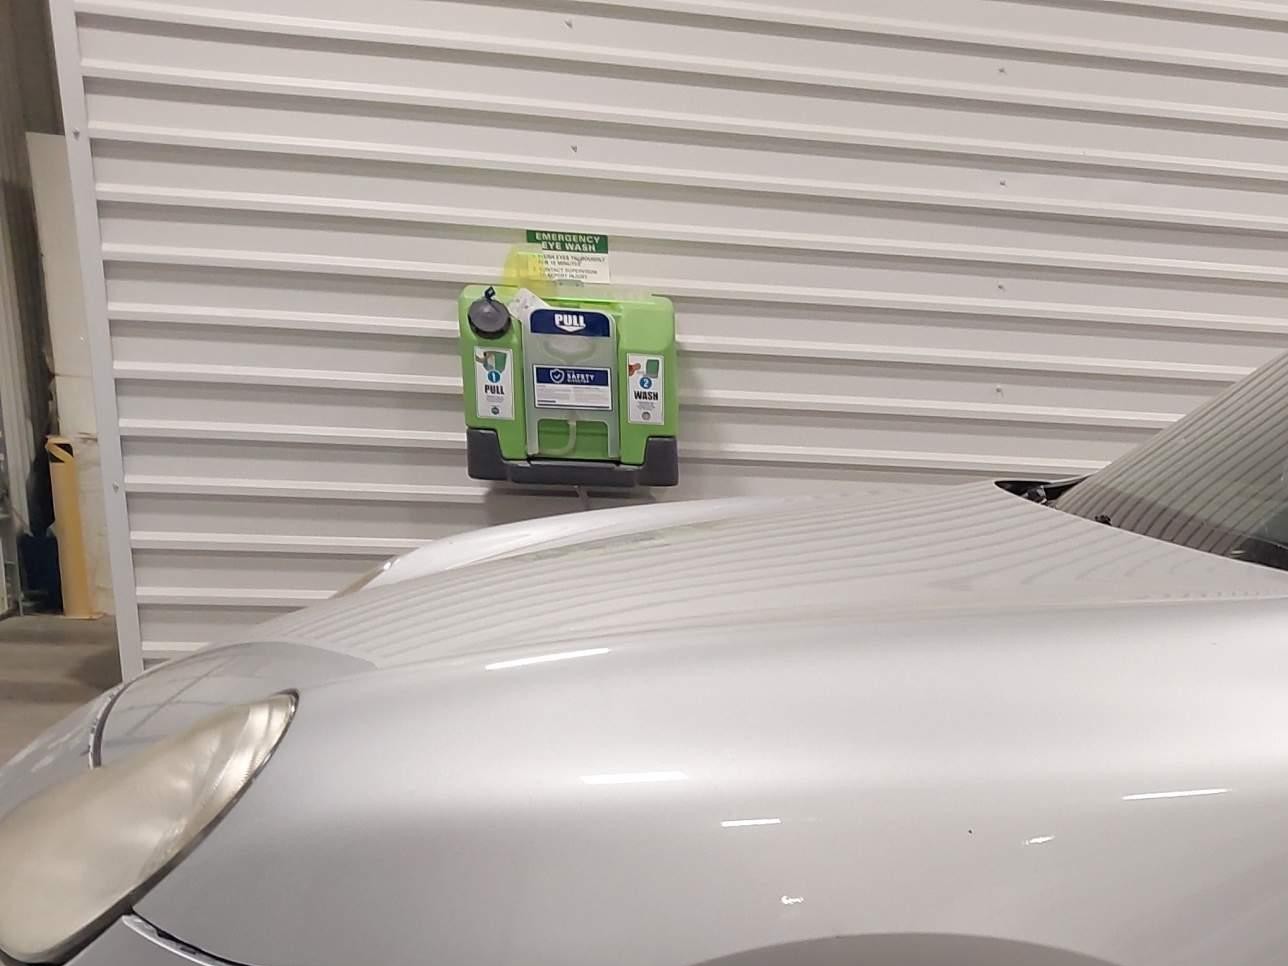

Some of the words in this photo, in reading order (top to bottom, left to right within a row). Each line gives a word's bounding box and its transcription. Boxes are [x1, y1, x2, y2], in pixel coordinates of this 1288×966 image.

[535, 232, 601, 244] EMERGENCY
[542, 241, 562, 250] EYE
[565, 243, 596, 252] WASH
[554, 314, 585, 327] PULL
[566, 373, 595, 381] SAFETY
[643, 378, 649, 388] 2
[484, 384, 505, 395] PULL
[633, 391, 659, 401] WASH
